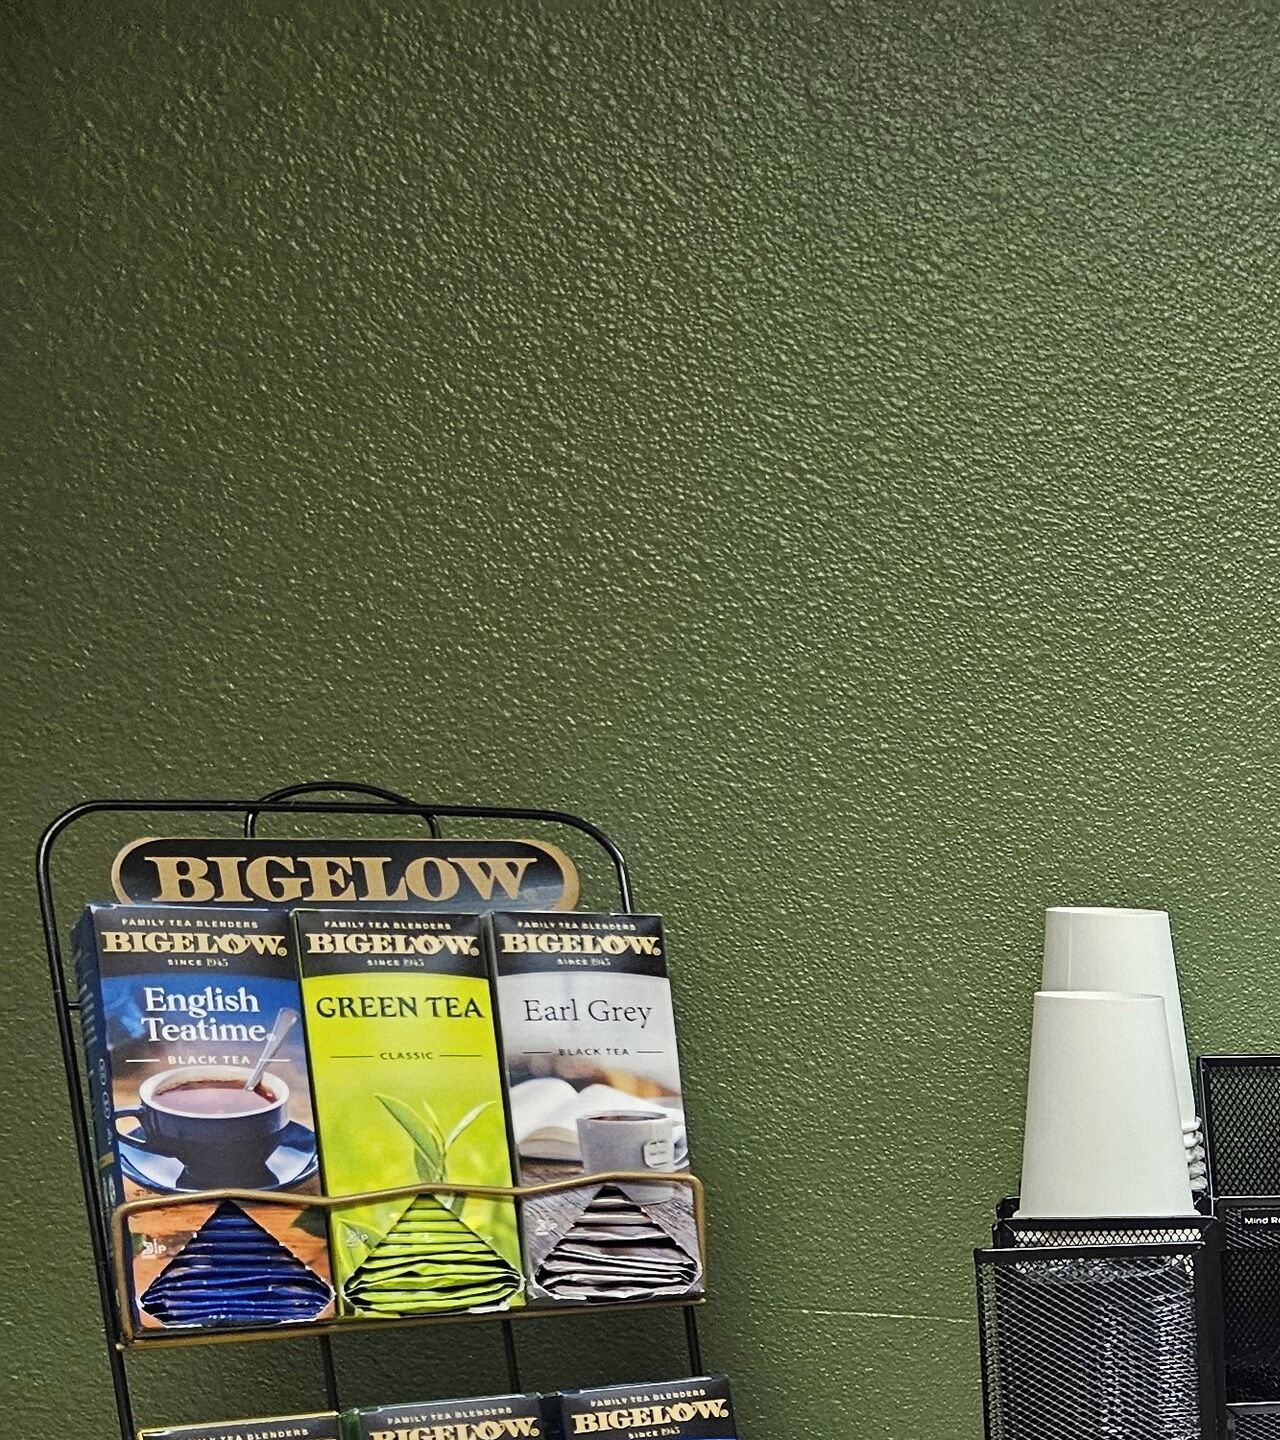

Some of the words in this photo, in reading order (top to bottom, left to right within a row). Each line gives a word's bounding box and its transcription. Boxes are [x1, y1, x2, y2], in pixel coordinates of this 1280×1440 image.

[144, 856, 538, 902] BIGELOW
[122, 918, 165, 927] FAMILY
[169, 919, 192, 928] TEA
[196, 920, 258, 930] BLENDERS
[324, 921, 364, 929] FAMILY
[393, 922, 451, 930] BLENDERS
[558, 922, 579, 930] TEA
[101, 931, 285, 956] BIGELOW
[305, 933, 478, 956] BIGELOW
[501, 933, 660, 956] BIGELOW
[143, 987, 261, 1017] English
[316, 997, 418, 1018] GREEN
[426, 997, 486, 1019] TEA
[523, 999, 579, 1023] Earl
[587, 1000, 653, 1029] Grey
[141, 1017, 266, 1043] Teatime
[380, 1052, 434, 1060] CLASSIC
[558, 1047, 601, 1057] BLACK
[606, 1048, 630, 1057] TEA
[168, 1056, 218, 1065] BLACK
[222, 1056, 251, 1065] TEA
[1244, 1217, 1269, 1225] Mind
[630, 1392, 650, 1403] TEA
[431, 1412, 452, 1420] TEA
[571, 1399, 727, 1435] BIGELOW
[247, 1428, 309, 1440] BLENDERS
